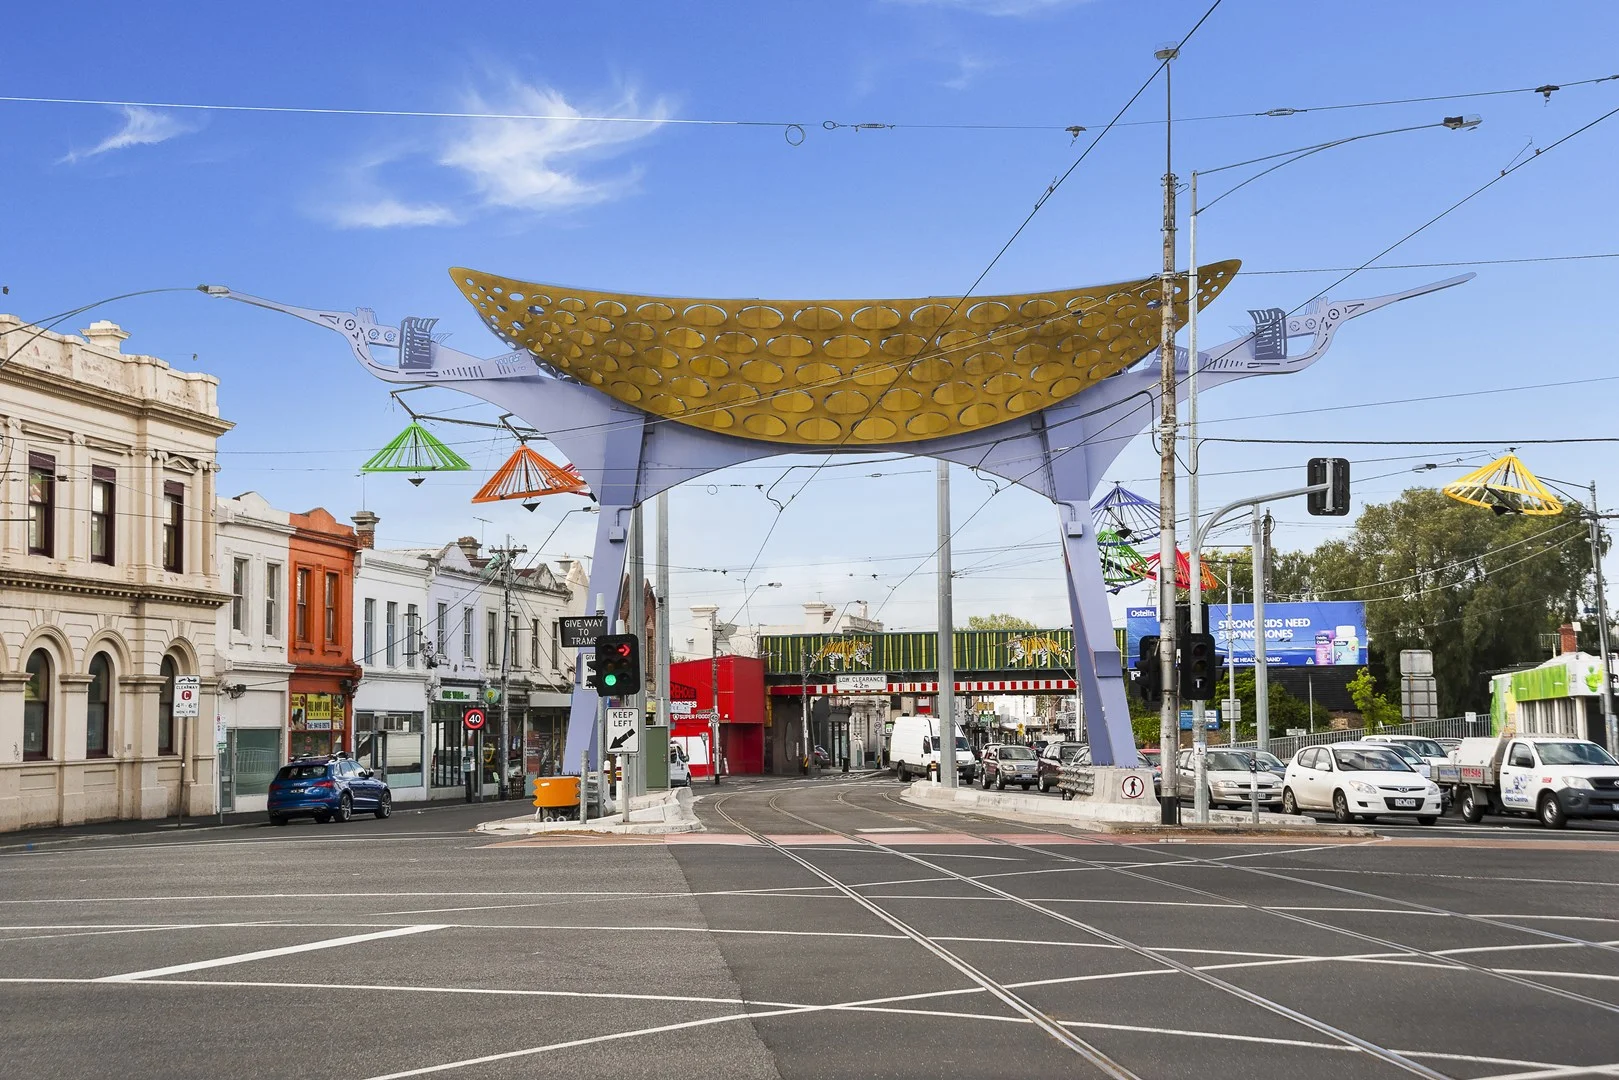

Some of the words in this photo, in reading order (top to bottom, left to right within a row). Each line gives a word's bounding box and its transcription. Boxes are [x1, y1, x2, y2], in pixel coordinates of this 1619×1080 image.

[564, 619, 582, 628] GIVE
[583, 619, 604, 627] WAY
[1285, 618, 1311, 627] NEED
[578, 628, 589, 636] TO
[571, 637, 598, 645] TRAMS
[468, 714, 482, 724] 40
[612, 711, 634, 719] KEEP
